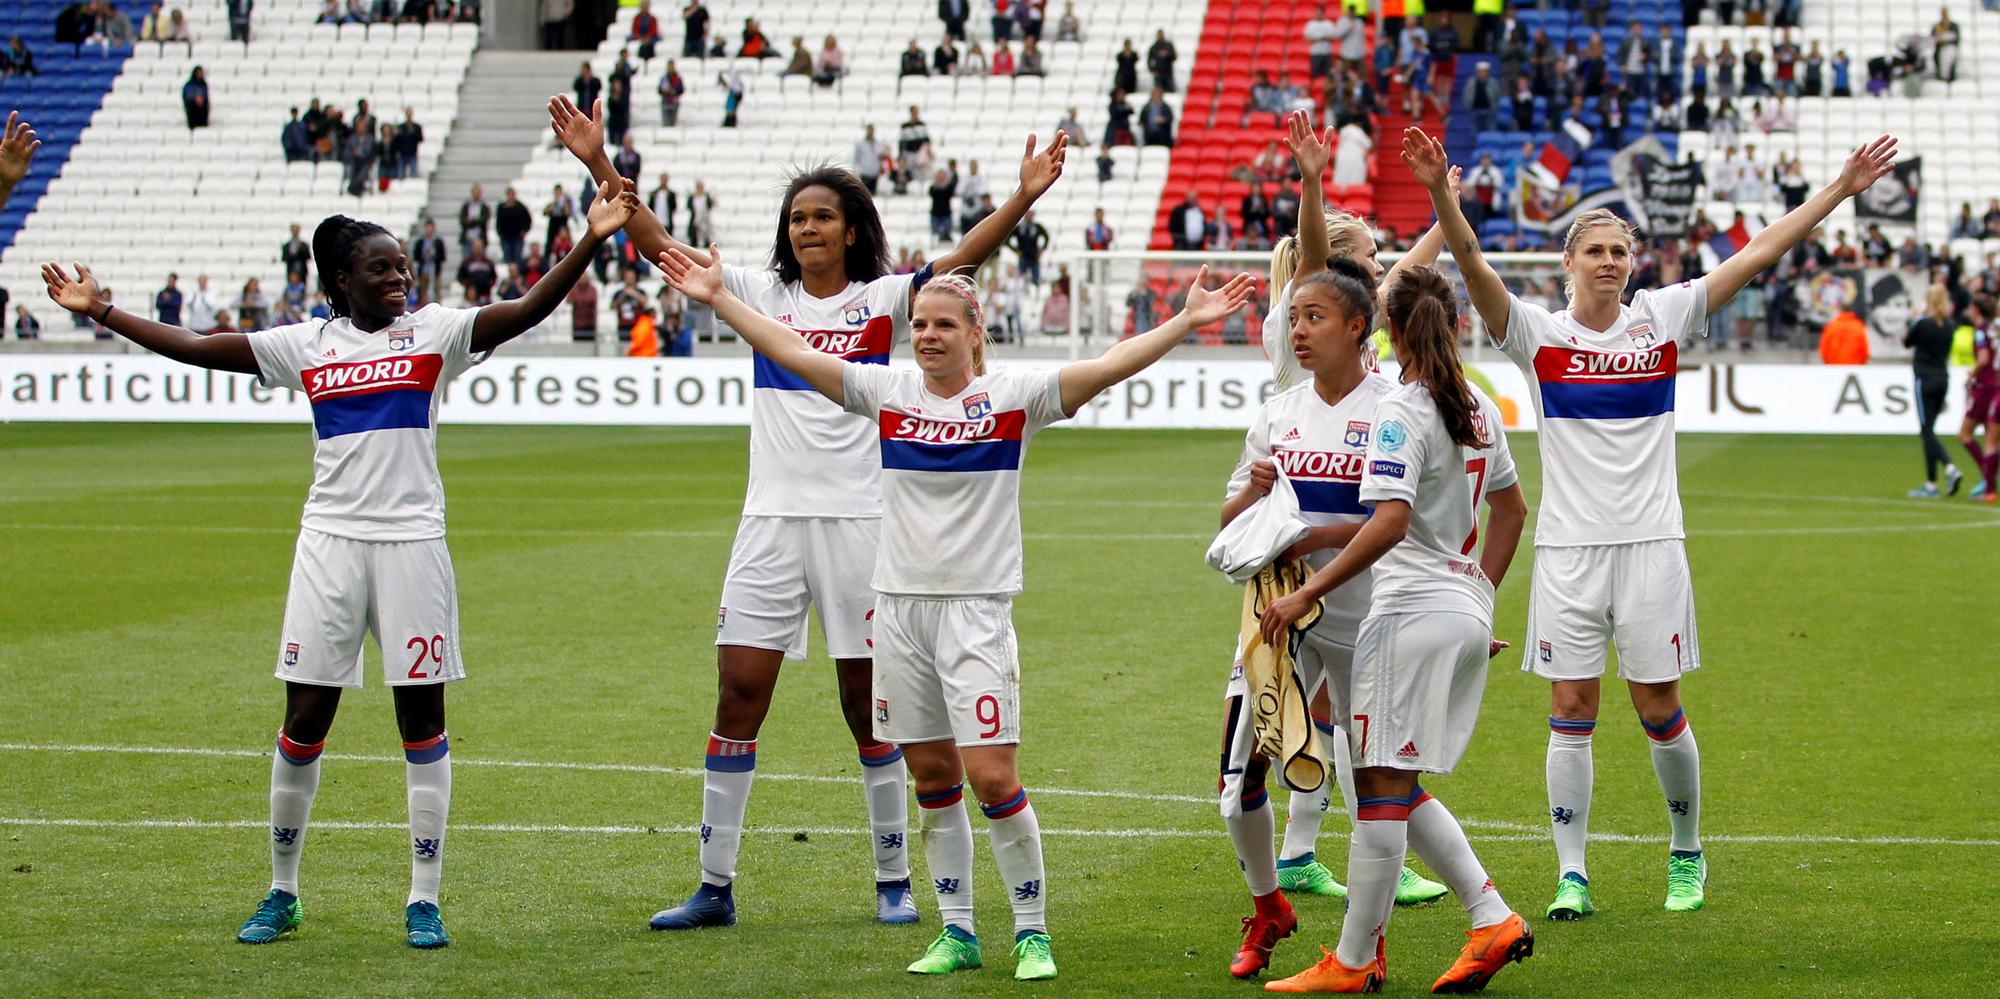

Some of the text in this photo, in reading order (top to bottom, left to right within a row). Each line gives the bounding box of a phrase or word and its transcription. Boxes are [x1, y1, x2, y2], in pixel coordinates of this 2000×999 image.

[311, 359, 413, 392] SWORD
[1566, 350, 1662, 373] SWORD
[895, 415, 996, 442] SWORD
[1273, 450, 1364, 477] SWORD
[1460, 458, 1486, 557] 7
[285, 652, 297, 663] OL
[407, 635, 443, 678] 29
[1670, 633, 1681, 672] 1
[976, 695, 1000, 738] 9
[1353, 714, 1369, 758] 7
